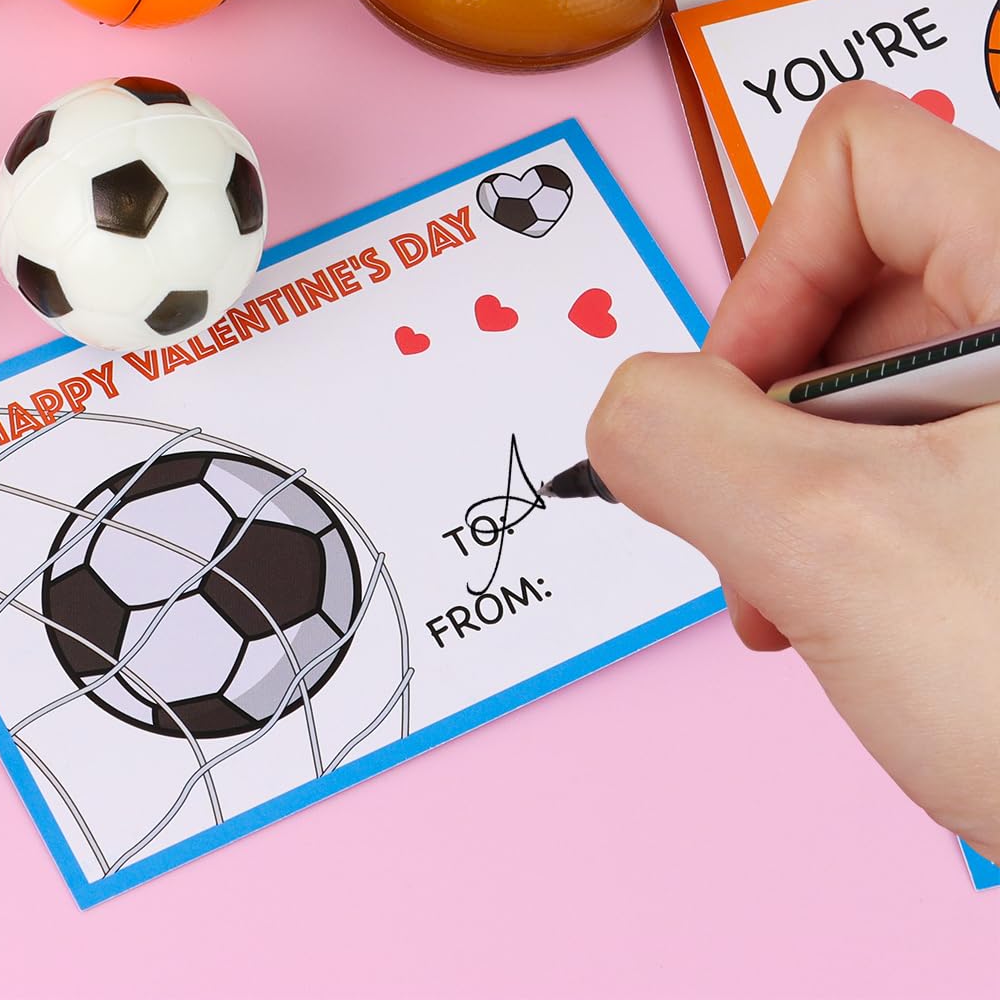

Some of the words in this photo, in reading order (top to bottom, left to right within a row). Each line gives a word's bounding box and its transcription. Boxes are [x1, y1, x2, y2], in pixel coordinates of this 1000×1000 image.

[743, 6, 948, 114] YOU'RE
[121, 246, 393, 382] VALENTINE'S
[389, 204, 477, 271] DAY
[442, 515, 515, 557] TO:
[425, 576, 553, 649] FROM:
